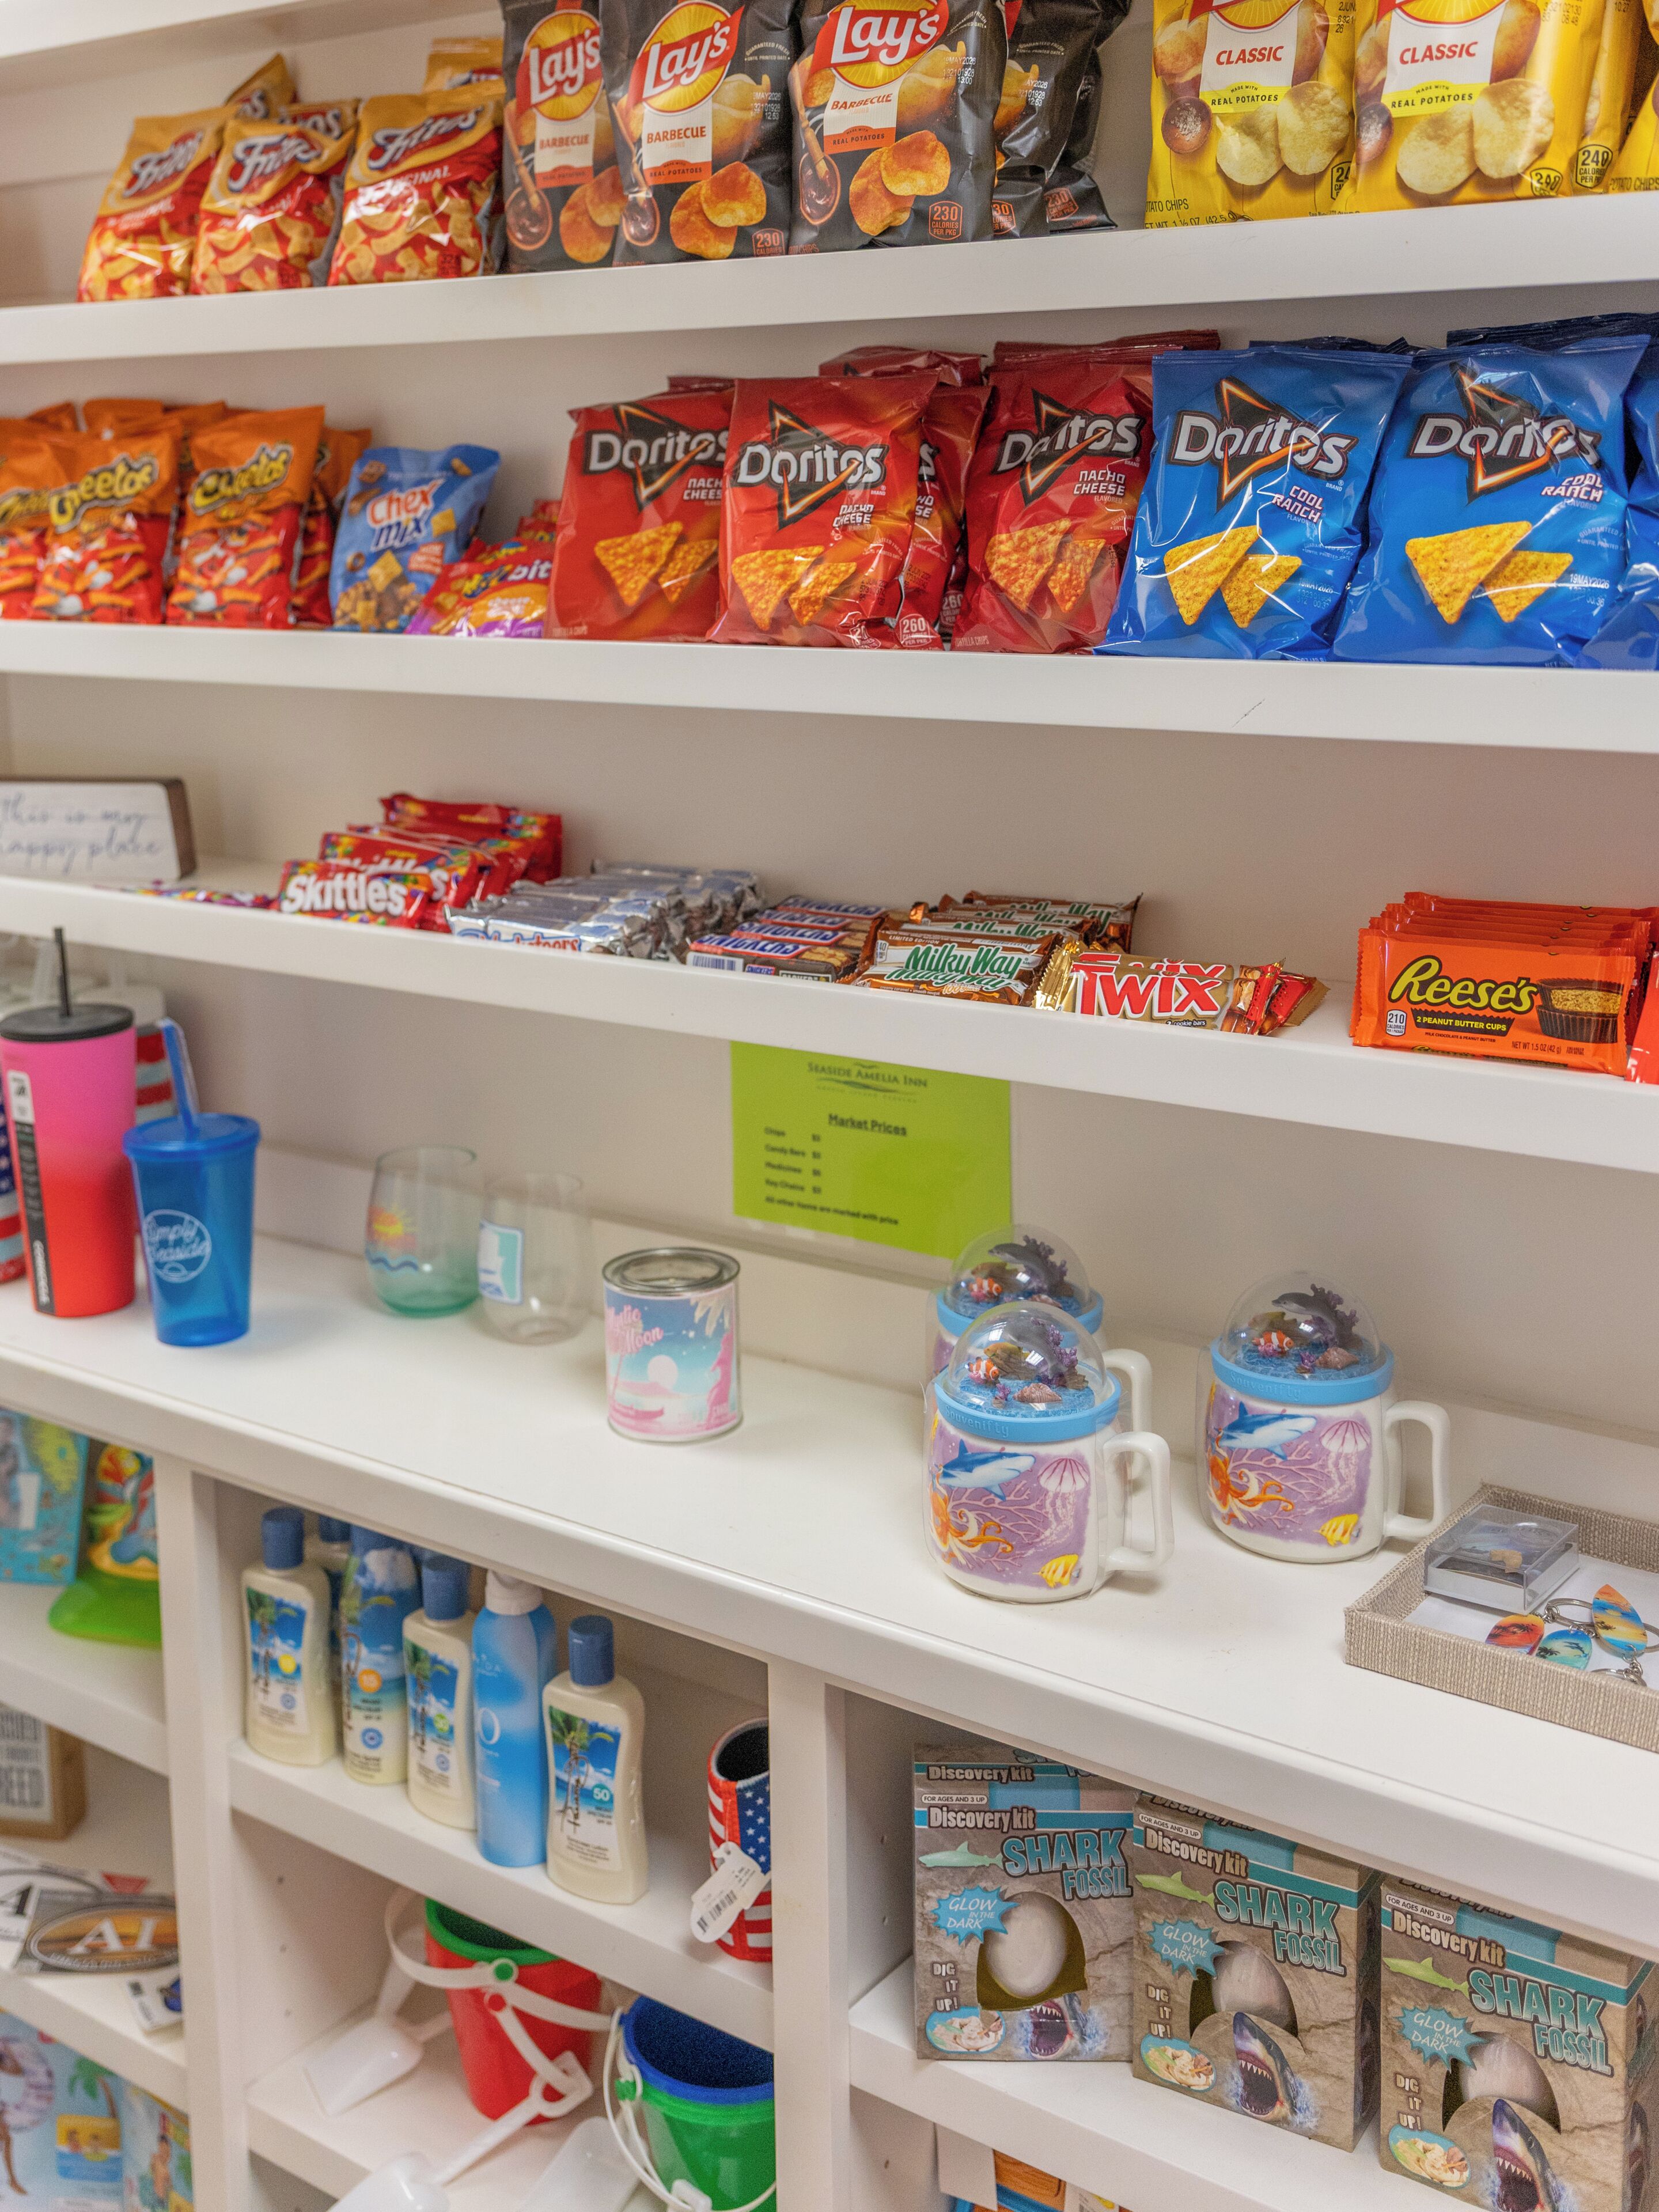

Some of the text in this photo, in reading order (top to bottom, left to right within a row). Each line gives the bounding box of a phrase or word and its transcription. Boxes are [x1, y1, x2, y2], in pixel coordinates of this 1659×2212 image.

[831, 6, 940, 65] Lay's
[642, 21, 730, 99] Lay's
[1215, 46, 1284, 66] CLASSIC
[1399, 41, 1479, 66] CLASSIC
[530, 29, 600, 105] Lay's
[1230, 85, 1244, 93] MADE
[1415, 85, 1433, 94] MADE
[831, 93, 893, 110] BARBECUE
[1211, 94, 1279, 106] REAL POTATOES
[1391, 92, 1474, 109] REAL POTATOES
[539, 134, 590, 150] BARBECUE
[647, 126, 707, 143] BARBECUE
[851, 133, 885, 142] POTATOES
[1581, 149, 1609, 166] 240
[668, 167, 702, 175] POTATOES
[1166, 198, 1188, 210] CHIPS
[934, 206, 958, 221] 230
[756, 232, 780, 248] 230
[588, 426, 728, 472] Doritos
[996, 414, 1141, 472] Doritos
[1174, 411, 1350, 474] Doritos
[1414, 417, 1601, 465] Doritos
[736, 442, 886, 485] Doritos
[1125, 459, 1140, 467] BRAND
[1079, 470, 1125, 483] NACHO
[1562, 473, 1603, 488] COOL
[1074, 483, 1125, 496] CHEESE
[1325, 482, 1342, 491] BRAND
[1541, 486, 1604, 502] RANCH
[369, 478, 446, 527] Chex
[1289, 485, 1324, 510] COOL
[1272, 493, 1321, 523] RANCH
[832, 513, 872, 527] CHEESE
[1579, 527, 1618, 538] GUARANTEED
[903, 618, 926, 632] 260
[280, 872, 407, 916] Skittles
[904, 943, 1022, 980] Milky Way
[1391, 957, 1537, 1012] Reese's
[1388, 1013, 1404, 1024] 210
[1423, 1017, 1453, 1026] PEANUT
[1455, 1020, 1484, 1028] BUTTER
[1486, 1022, 1506, 1031] CUPS
[1512, 1041, 1521, 1049] NET
[1547, 1044, 1555, 1053] (42
[1556, 1045, 1562, 1055] g)
[808, 1062, 851, 1077] SEASIDE
[857, 1069, 899, 1084] AMELIA
[828, 1112, 907, 1136] Market Prices
[1230, 1371, 1301, 1402] Souvenifty
[945, 1405, 1009, 1438] Souvenifty
[928, 1766, 1035, 1783] Discovery kit
[593, 1787, 611, 1802] 50
[929, 1806, 1036, 1832] Discovery kit
[1141, 1814, 1152, 1823] FOR
[1153, 1818, 1169, 1829] AGES
[1170, 1823, 1184, 1834] AND
[1190, 1830, 1199, 1838] UP
[1002, 1830, 1127, 1876] SHARK
[1145, 1827, 1248, 1878] Discovery kit
[1063, 1866, 1131, 1900] FOSSIL
[949, 1898, 997, 1911] GLOW
[1215, 1880, 1340, 1943] SHARK
[1388, 1896, 1400, 1906] FOR
[1401, 1900, 1419, 1913] AGES
[1419, 1906, 1435, 1918] AND
[1441, 1914, 1452, 1923] UP
[947, 1918, 982, 1929] DARK
[1162, 1925, 1209, 1949] GLOW
[1393, 1910, 1506, 1968] Discovery kit
[1161, 1944, 1195, 1965] DARK
[1192, 1947, 1207, 1957] THE
[1274, 1929, 1345, 1976] FOSSIL
[933, 1963, 956, 1976] DIG
[945, 1979, 959, 1993] IT
[1147, 1985, 1170, 2003] DIG
[935, 1997, 959, 2012] UP!
[1468, 1968, 1605, 2039] SHARK
[1160, 2006, 1172, 2020] IT
[1150, 2022, 1172, 2039] UP!
[1413, 2012, 1464, 2038] GLOW
[1411, 2030, 1448, 2054] DARK
[1434, 2033, 1461, 2048] IN THE
[1535, 2023, 1613, 2075] FOSSIL
[1395, 2074, 1420, 2093] DIG
[1408, 2096, 1422, 2111] IT
[1398, 2112, 1422, 2131] UP!
